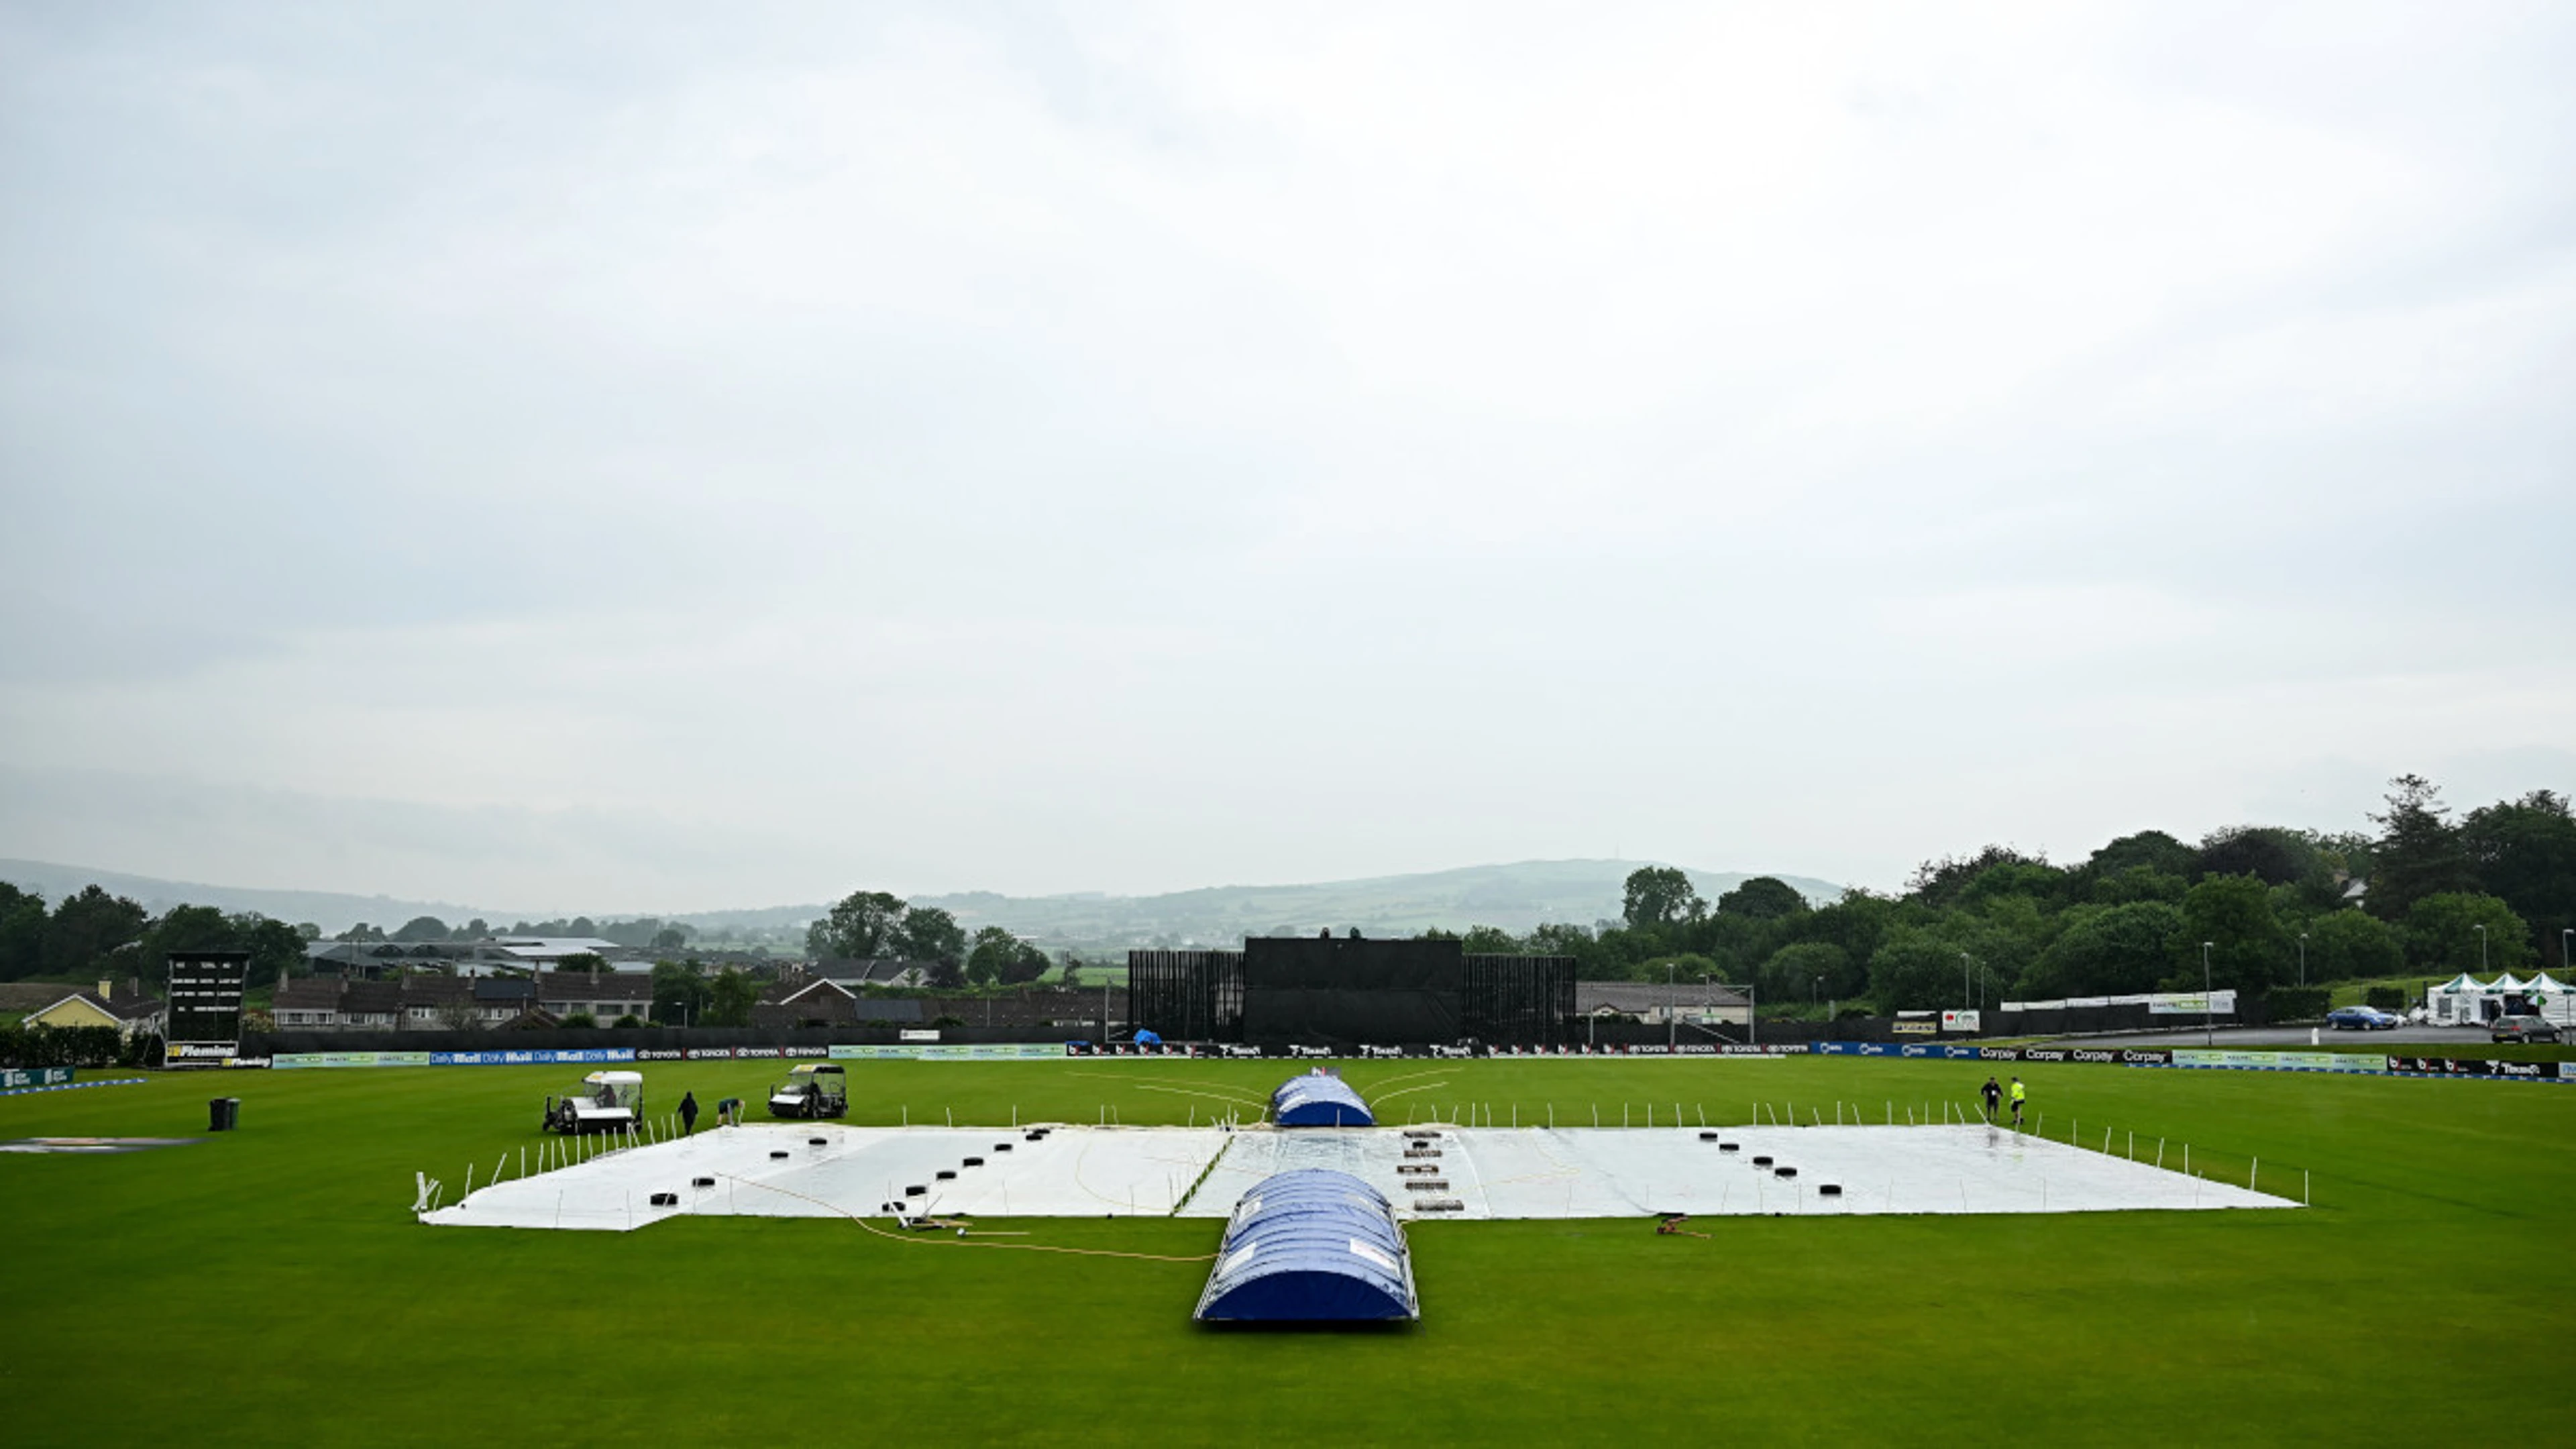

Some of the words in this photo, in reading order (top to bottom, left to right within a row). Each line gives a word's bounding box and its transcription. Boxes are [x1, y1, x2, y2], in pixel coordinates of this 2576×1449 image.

[180, 1044, 235, 1057] Fleming
[1981, 1046, 2019, 1061] Corpay
[2026, 1049, 2065, 1061] Corpay
[2074, 1049, 2113, 1063] Corpay
[2123, 1049, 2166, 1063] Corpay
[231, 1056, 271, 1067] Fleming
